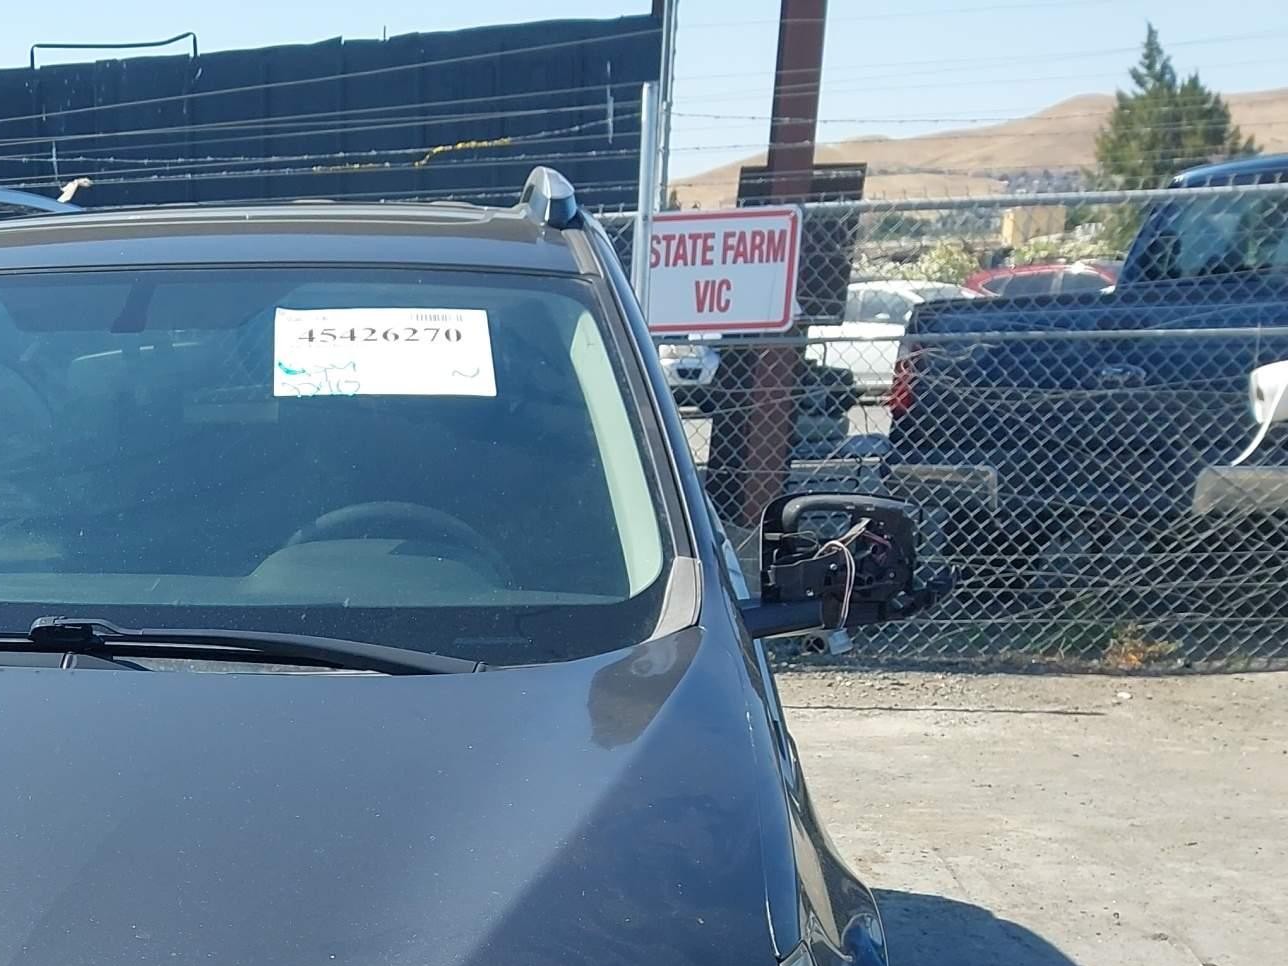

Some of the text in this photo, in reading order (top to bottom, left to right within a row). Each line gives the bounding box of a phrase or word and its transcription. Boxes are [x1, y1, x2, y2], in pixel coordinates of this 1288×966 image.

[650, 229, 788, 269] STATE FARM
[694, 278, 732, 313] VIC
[298, 326, 463, 343] 45426270
